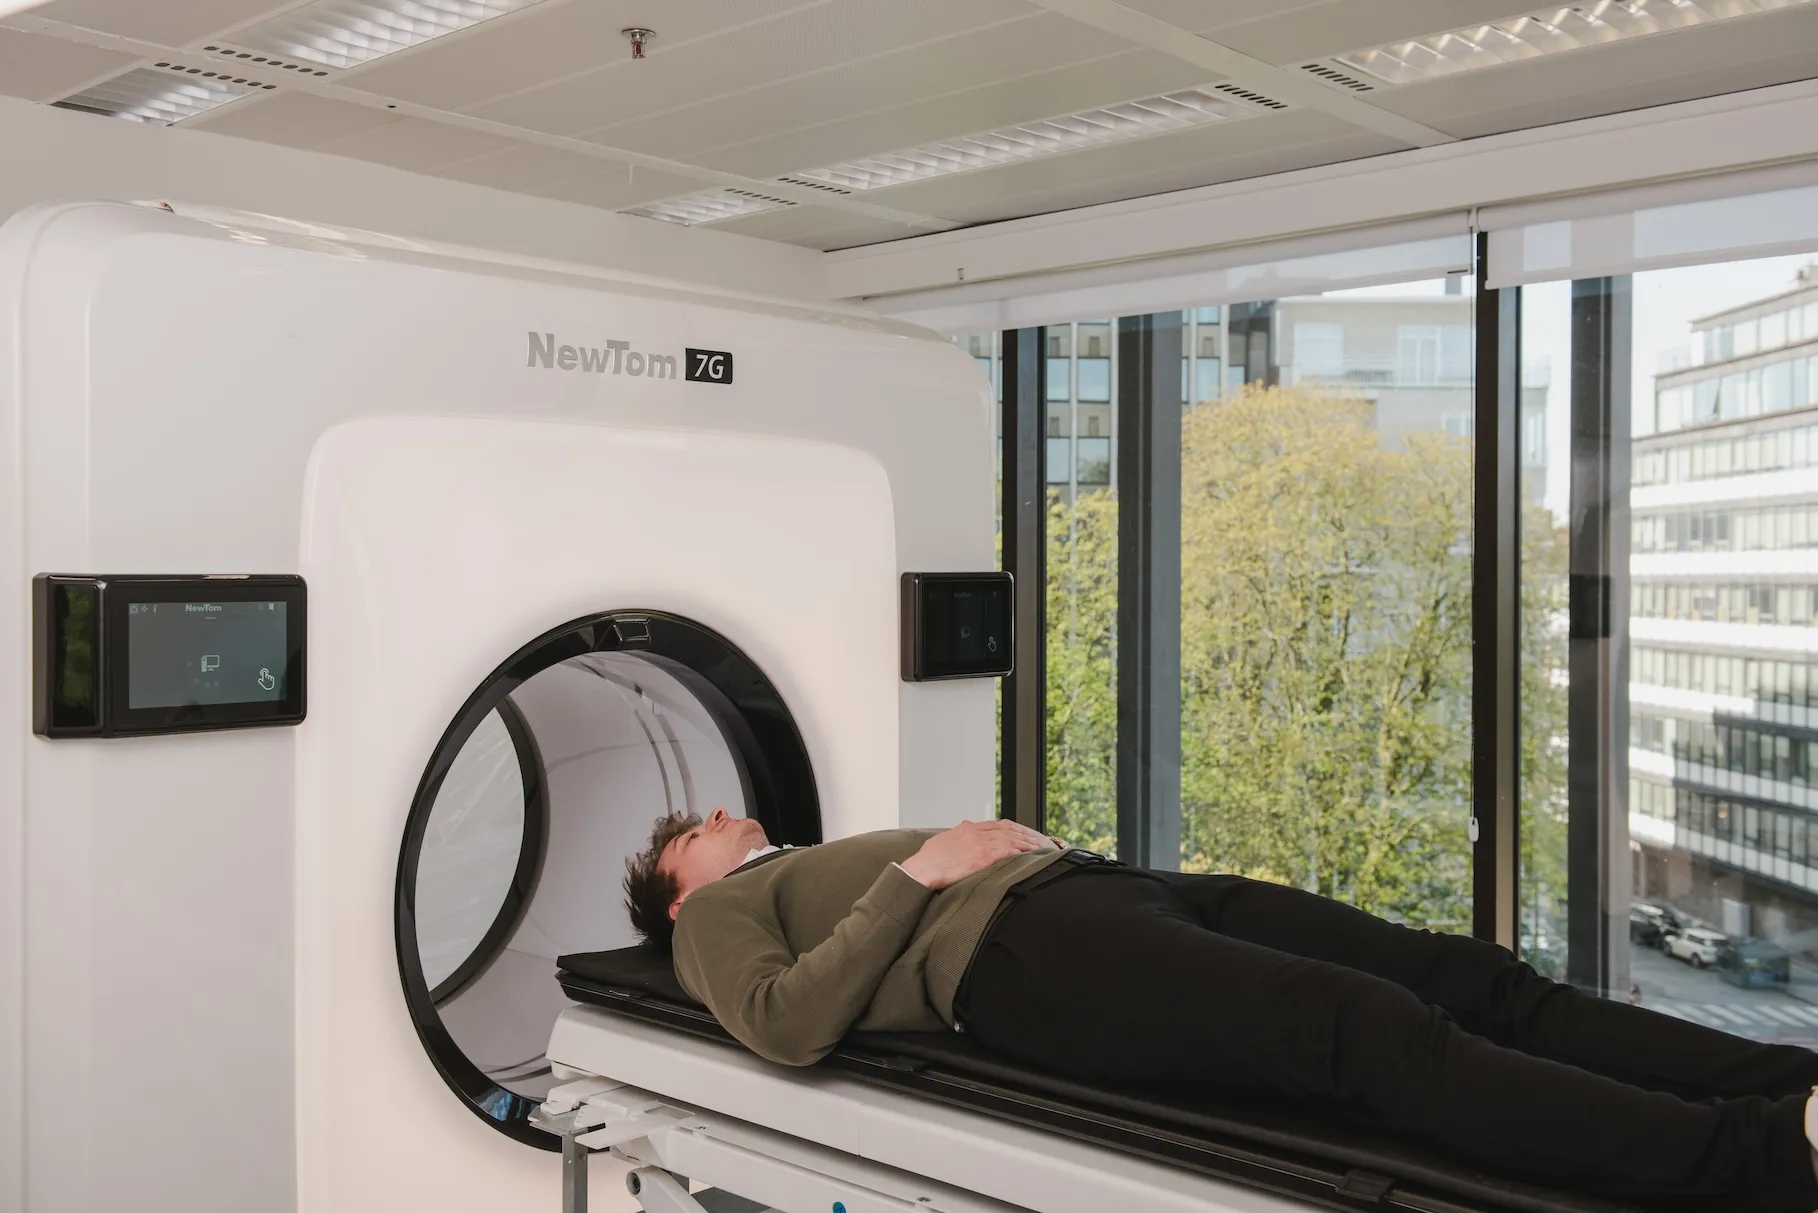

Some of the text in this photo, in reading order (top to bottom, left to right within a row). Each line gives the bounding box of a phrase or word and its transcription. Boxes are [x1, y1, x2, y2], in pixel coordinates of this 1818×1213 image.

[526, 331, 725, 380] NewTom 7G
[185, 603, 222, 613] NewTom
